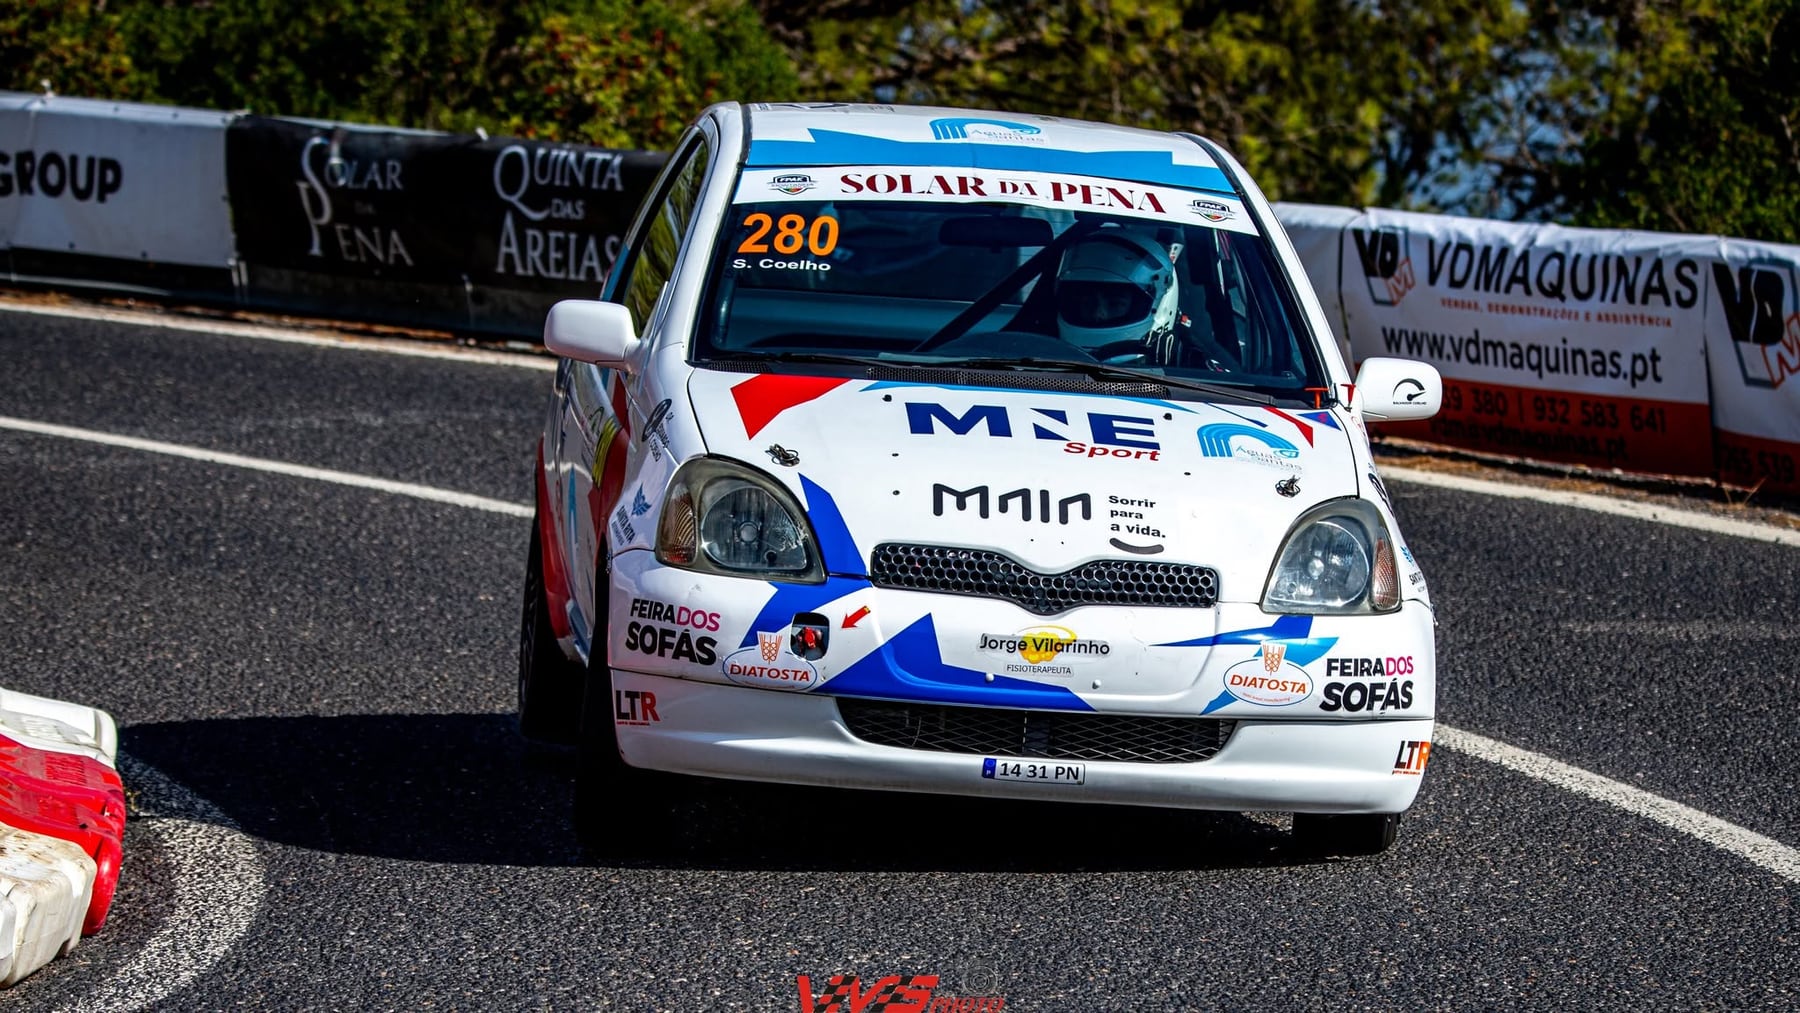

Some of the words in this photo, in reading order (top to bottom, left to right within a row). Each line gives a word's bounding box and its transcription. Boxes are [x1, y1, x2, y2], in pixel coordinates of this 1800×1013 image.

[493, 145, 624, 221] QUINTA
[839, 173, 988, 197] SOLAR
[1000, 181, 1039, 196] DA
[1049, 181, 1168, 214] PENA
[551, 198, 584, 219] DAS
[737, 212, 840, 257] 280
[732, 258, 752, 269] S.
[759, 258, 831, 271] Coelho
[1427, 238, 1698, 309] VDMAQUINAS
[1440, 298, 1484, 314] VENDAS,
[1584, 311, 1592, 323] E
[1382, 324, 1663, 388] www.vdmaquinas.pt
[1532, 396, 1571, 424] 932
[1579, 402, 1620, 430] 583
[1630, 406, 1667, 434] 641
[1063, 441, 1161, 462] Sport
[1108, 495, 1156, 508] Sorrir
[1110, 509, 1144, 519] para
[1110, 523, 1120, 532] a
[1126, 524, 1166, 538] vida.
[625, 623, 718, 666] SOFÁS
[979, 637, 1028, 654] Jorge
[1032, 638, 1110, 656] Vilarinho
[729, 663, 809, 682] DIATOSTA
[1006, 664, 1072, 675] FISIOTERAPEUTA
[1229, 674, 1307, 695] DIATOSTA
[1319, 678, 1413, 712] SOFÁS
[615, 690, 661, 722] LTR
[1394, 740, 1431, 769] LTR
[1000, 763, 1022, 778] 14
[1026, 764, 1048, 779] 31
[1054, 766, 1079, 781] PN
